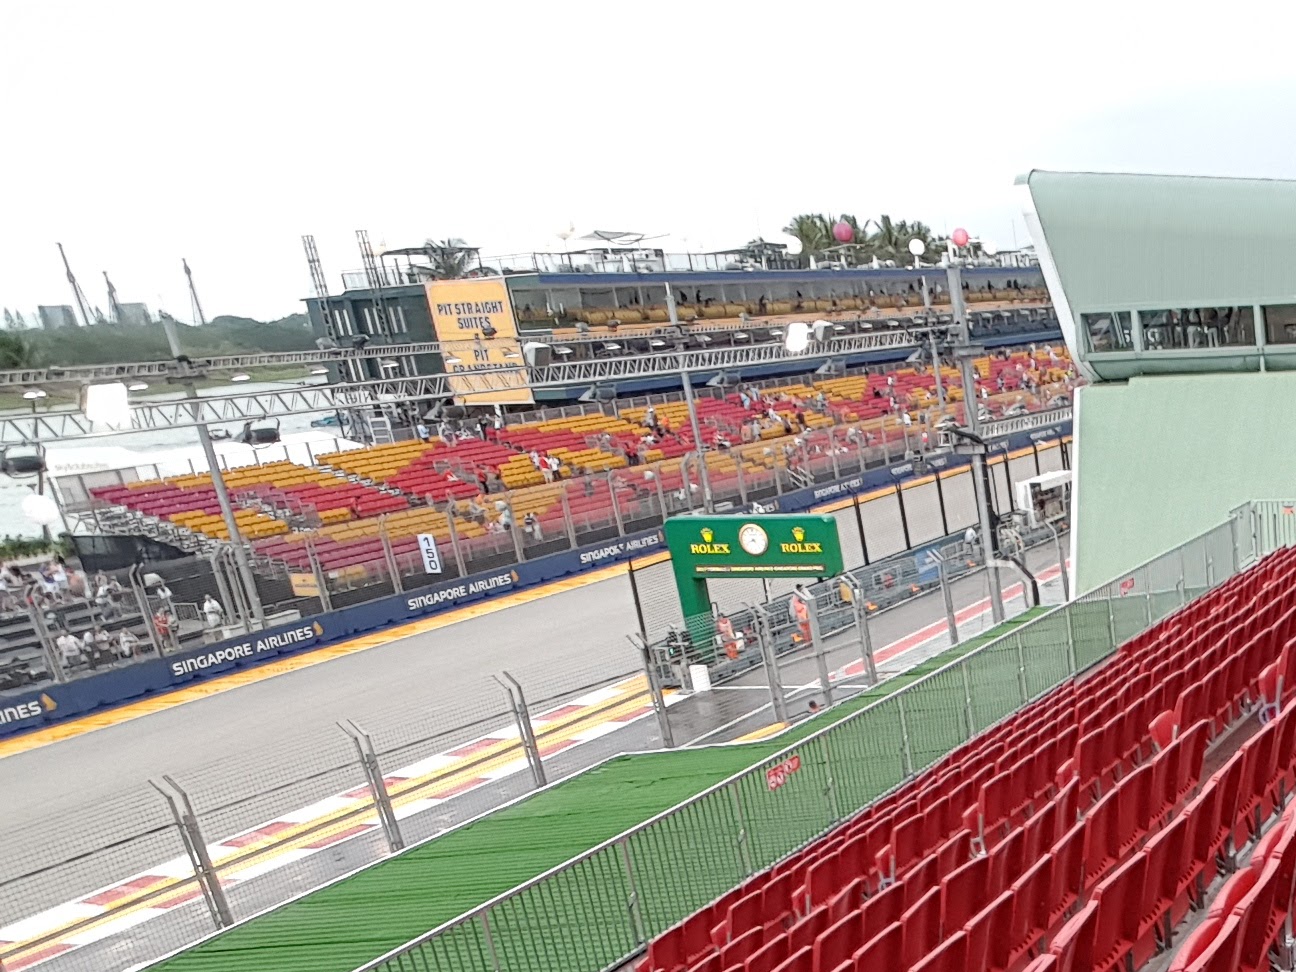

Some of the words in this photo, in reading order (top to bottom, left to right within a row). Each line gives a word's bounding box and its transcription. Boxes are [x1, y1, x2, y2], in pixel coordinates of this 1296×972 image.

[437, 303, 453, 315] PIT
[455, 301, 504, 314] STRAIGHT
[457, 317, 491, 329] SUITES
[474, 349, 489, 361] PIT
[626, 535, 659, 551] AIRLINES
[690, 543, 731, 554] ROLEX
[780, 543, 823, 553] ROLEX
[423, 537, 438, 570] 150
[408, 585, 467, 610] SINGAPORE
[469, 573, 511, 593] AIRLINES
[172, 642, 252, 676] SINGAPORE
[256, 626, 314, 653] AIRLINES
